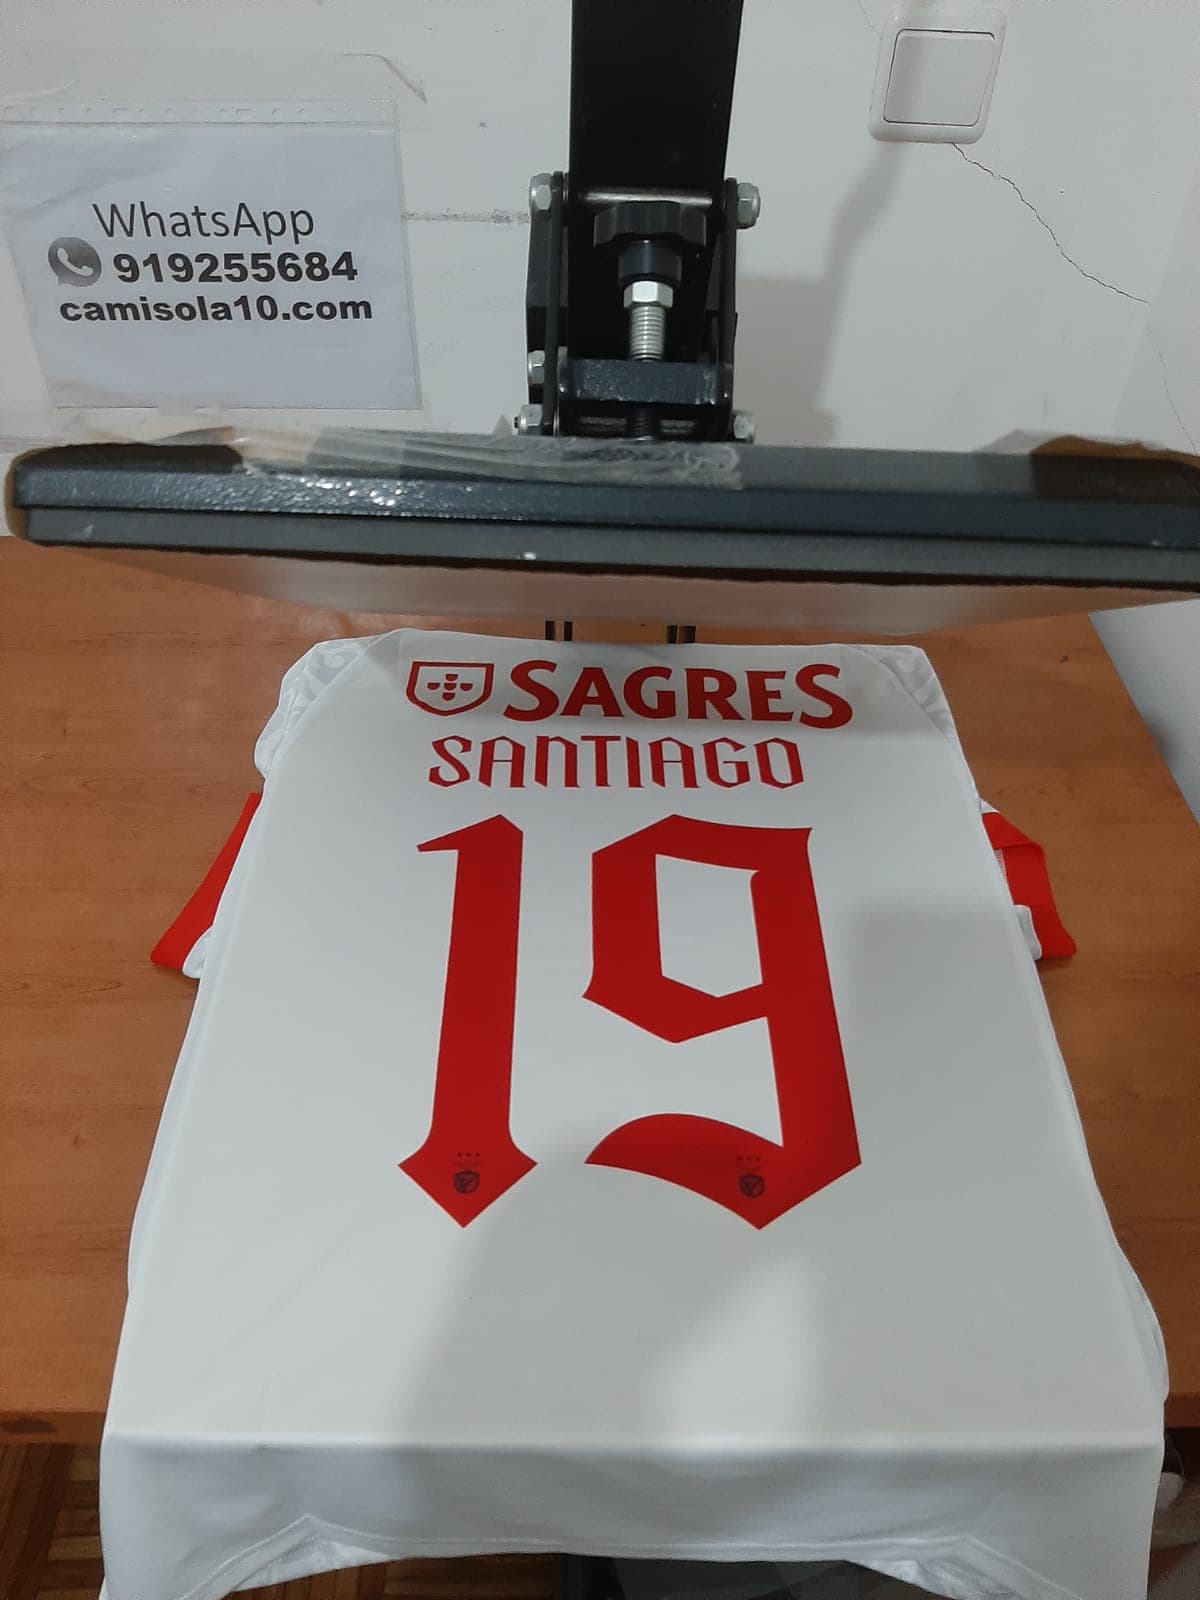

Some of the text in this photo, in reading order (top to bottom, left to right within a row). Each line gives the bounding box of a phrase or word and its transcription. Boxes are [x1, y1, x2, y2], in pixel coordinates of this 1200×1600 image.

[92, 201, 314, 244] WhatsApp
[113, 251, 358, 283] 919255684
[60, 295, 373, 321] camisola10.com
[503, 660, 853, 729] SAGRES
[428, 735, 804, 789] SANTIAGO
[399, 814, 862, 1230] 19
